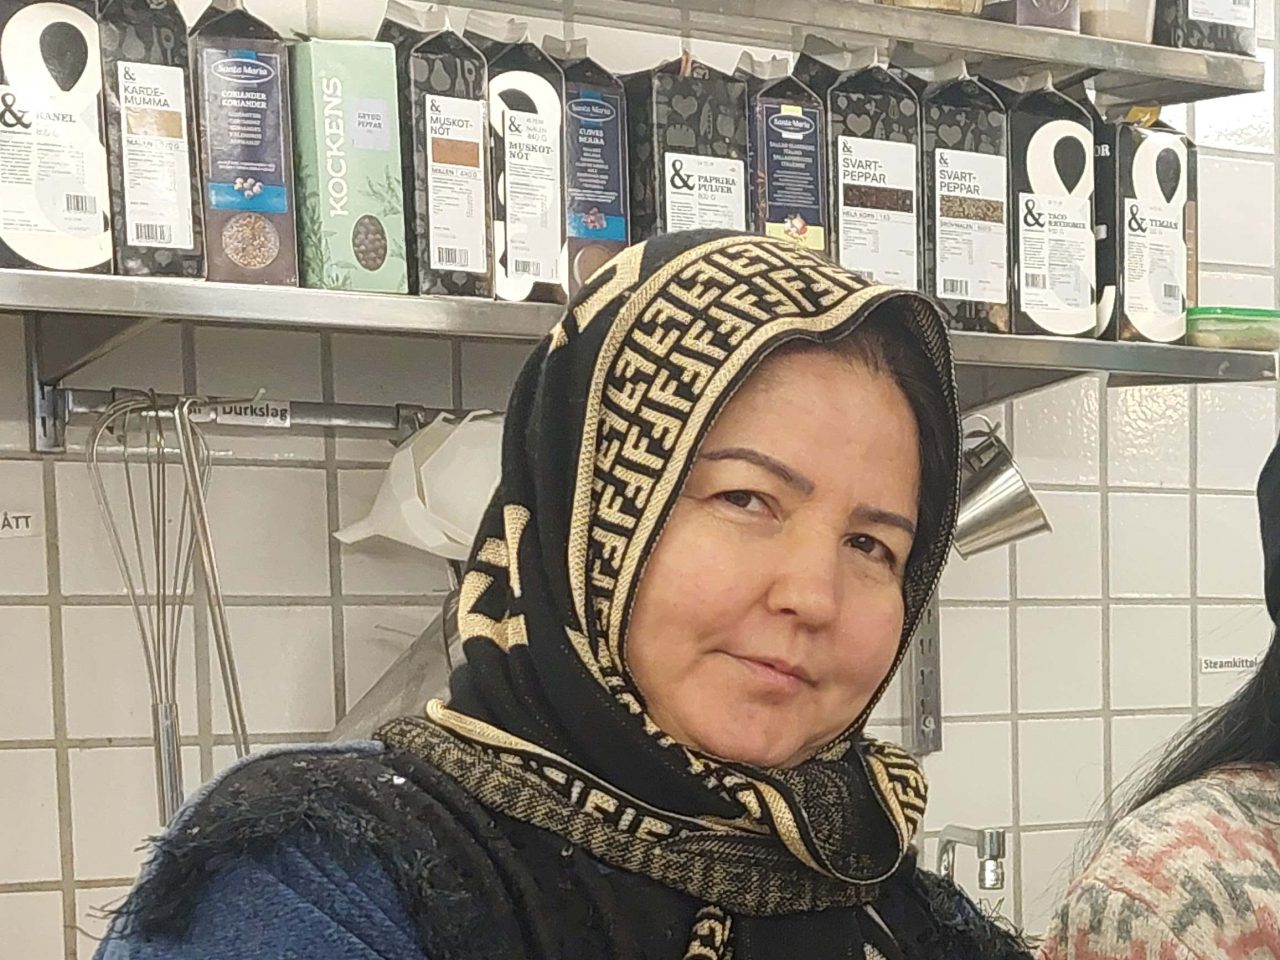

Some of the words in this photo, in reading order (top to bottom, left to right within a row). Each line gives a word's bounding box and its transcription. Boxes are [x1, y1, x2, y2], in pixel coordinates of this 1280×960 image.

[124, 66, 136, 81] &
[218, 62, 242, 74] Santa
[243, 65, 269, 76] Maria
[124, 85, 165, 97] KARDE-
[125, 95, 170, 108] MUMMA
[221, 99, 268, 109] KORIANDER
[430, 99, 441, 113] &
[0, 93, 32, 129] &
[36, 111, 77, 123] KANEL
[430, 115, 473, 129] MUSKOT-
[508, 115, 522, 134] &
[321, 77, 349, 217] KOCKENS
[509, 141, 555, 155] MUSKOT-
[842, 139, 853, 153] &
[842, 157, 883, 171] SVART-
[939, 152, 949, 165] &
[670, 159, 695, 191] &
[842, 169, 888, 185] PEPPAR
[939, 169, 977, 183] SVART-
[697, 183, 733, 194] PULVER
[939, 181, 980, 196] PEPPAR
[1023, 199, 1046, 228] &
[1047, 212, 1068, 221] TACO
[1128, 203, 1148, 233] &
